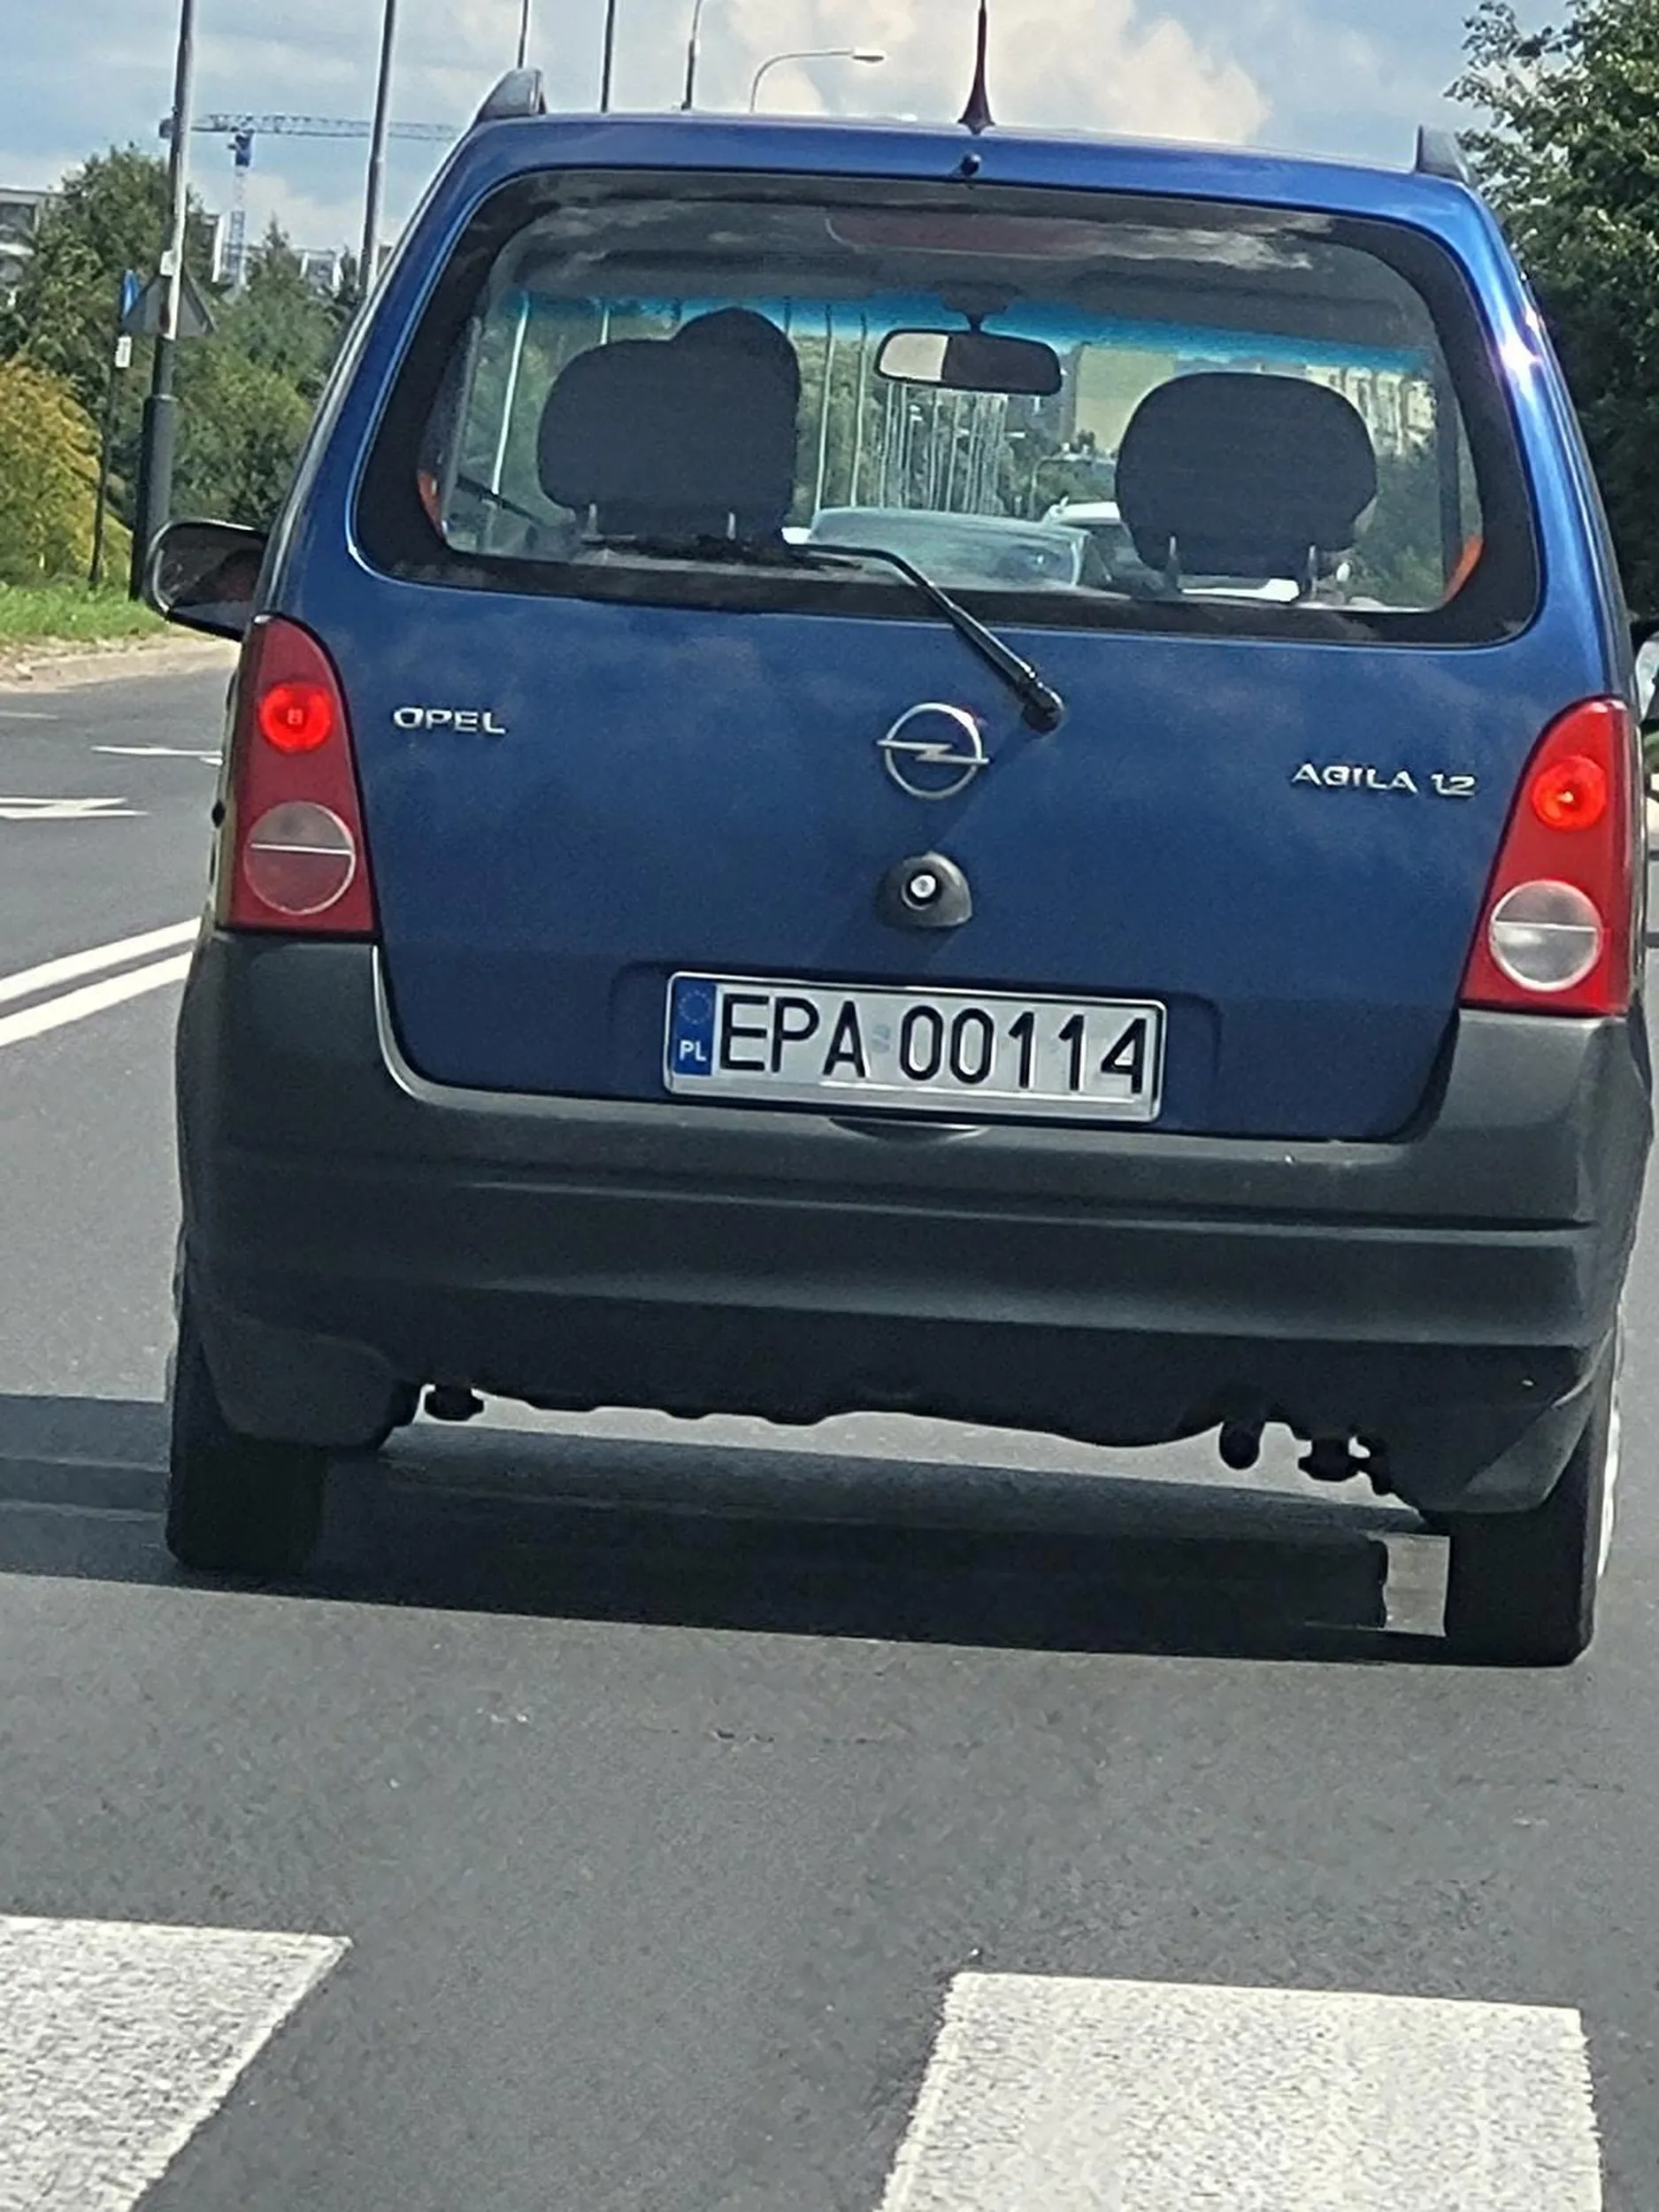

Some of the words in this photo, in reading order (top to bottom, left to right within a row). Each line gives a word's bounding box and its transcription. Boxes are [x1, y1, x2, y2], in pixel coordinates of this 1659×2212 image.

[394, 707, 506, 734] OPEL
[1291, 763, 1418, 794] AGILA
[679, 1040, 707, 1062] PL
[718, 994, 868, 1078] EPA
[899, 1004, 1148, 1094] 00114
